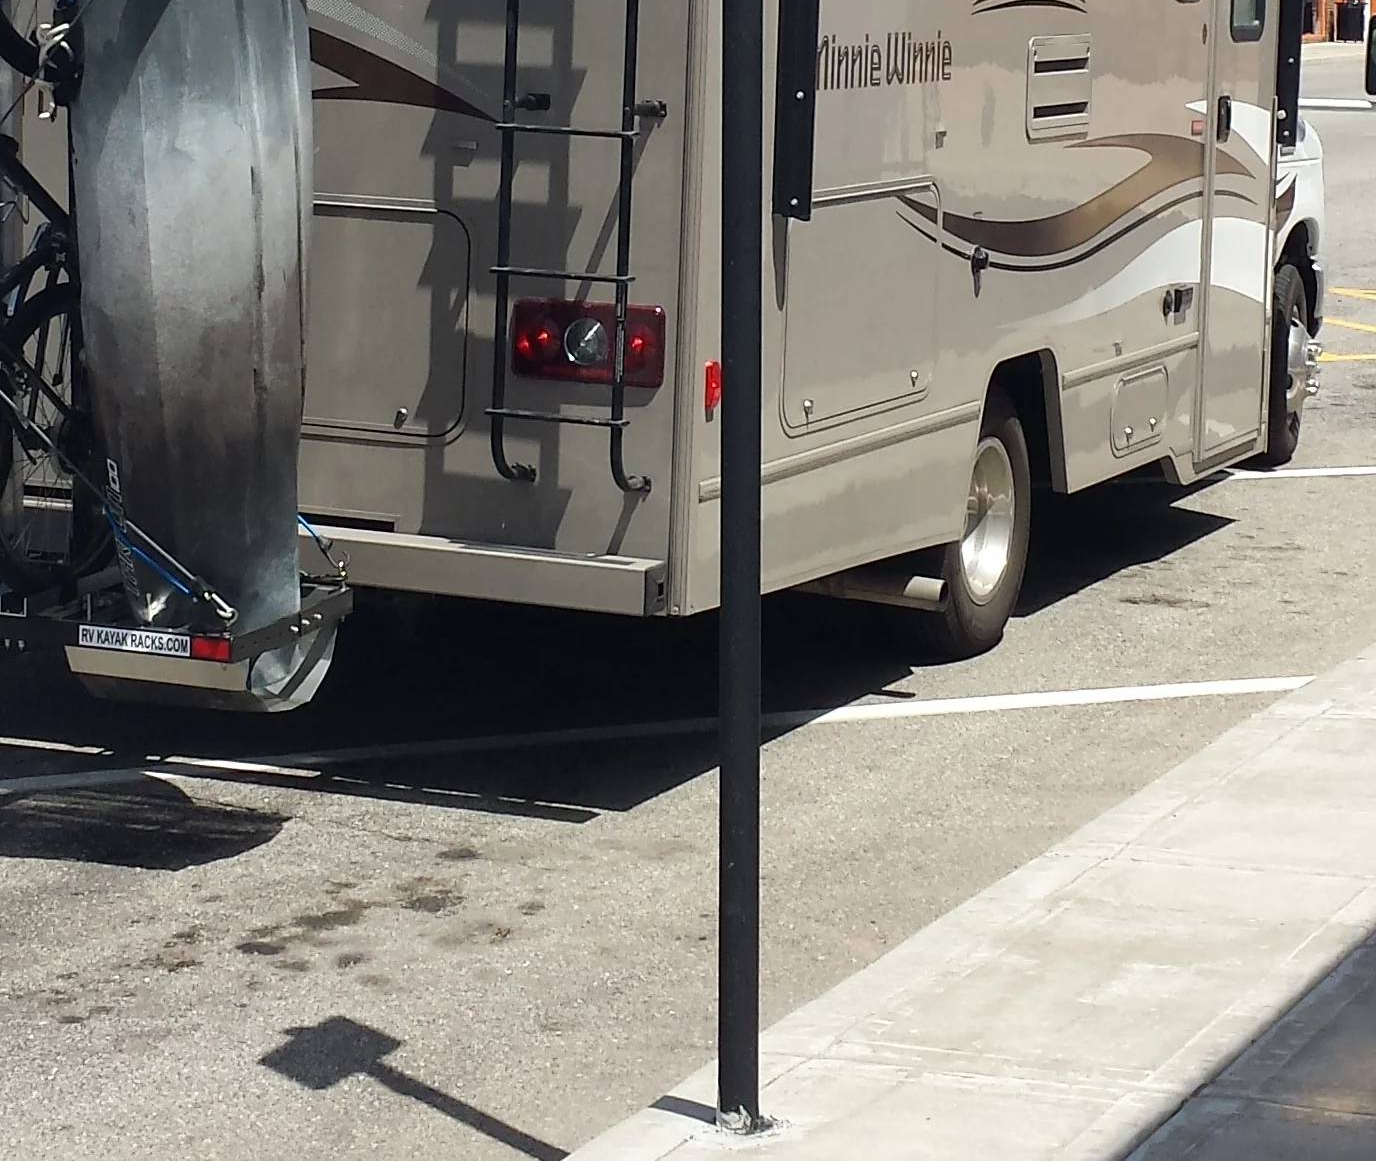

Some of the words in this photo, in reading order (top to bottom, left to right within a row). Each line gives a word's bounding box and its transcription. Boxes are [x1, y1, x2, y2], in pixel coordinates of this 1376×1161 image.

[886, 30, 952, 86] Winnie
[81, 627, 95, 643] RV
[96, 629, 130, 647] KAYAK
[130, 633, 189, 653] RACKS.COM
